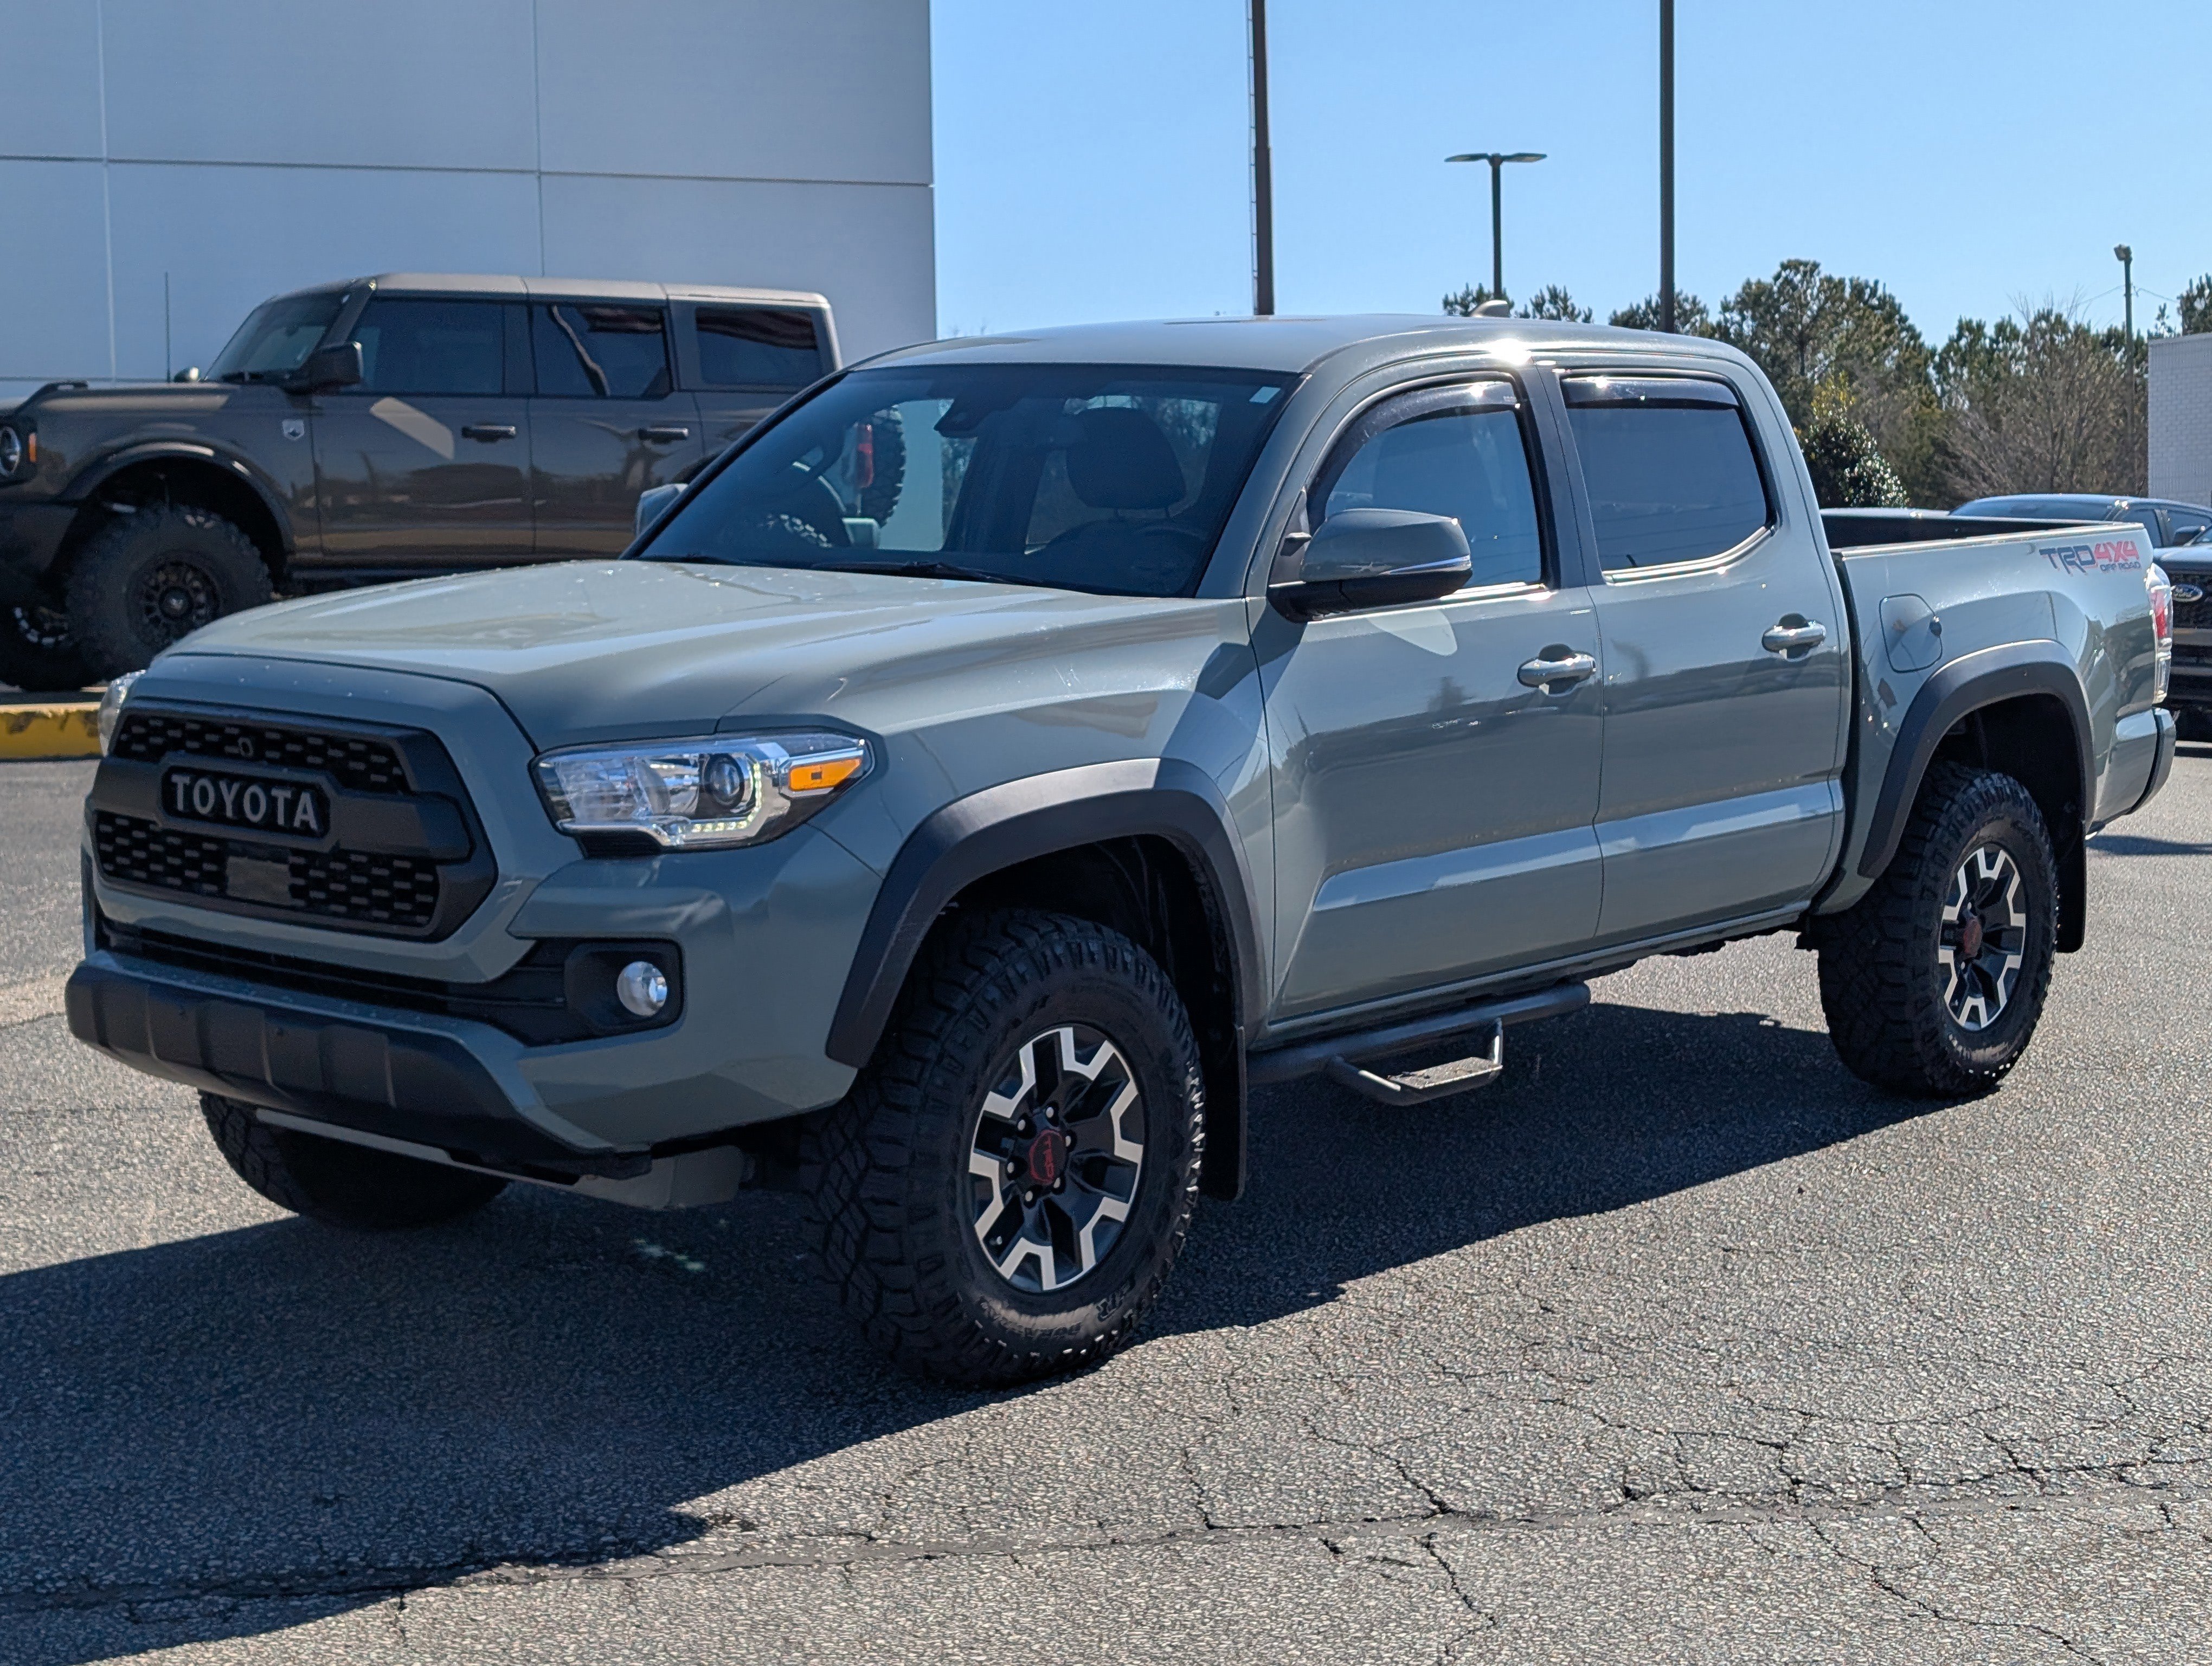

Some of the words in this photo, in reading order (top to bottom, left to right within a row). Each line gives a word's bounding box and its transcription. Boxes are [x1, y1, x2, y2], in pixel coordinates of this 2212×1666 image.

[2039, 545, 2098, 575] TRD
[2095, 541, 2140, 562] 4X4
[2100, 563, 2116, 572] OFF
[2118, 561, 2141, 569] ROAD
[171, 773, 319, 831] TOYOTA
